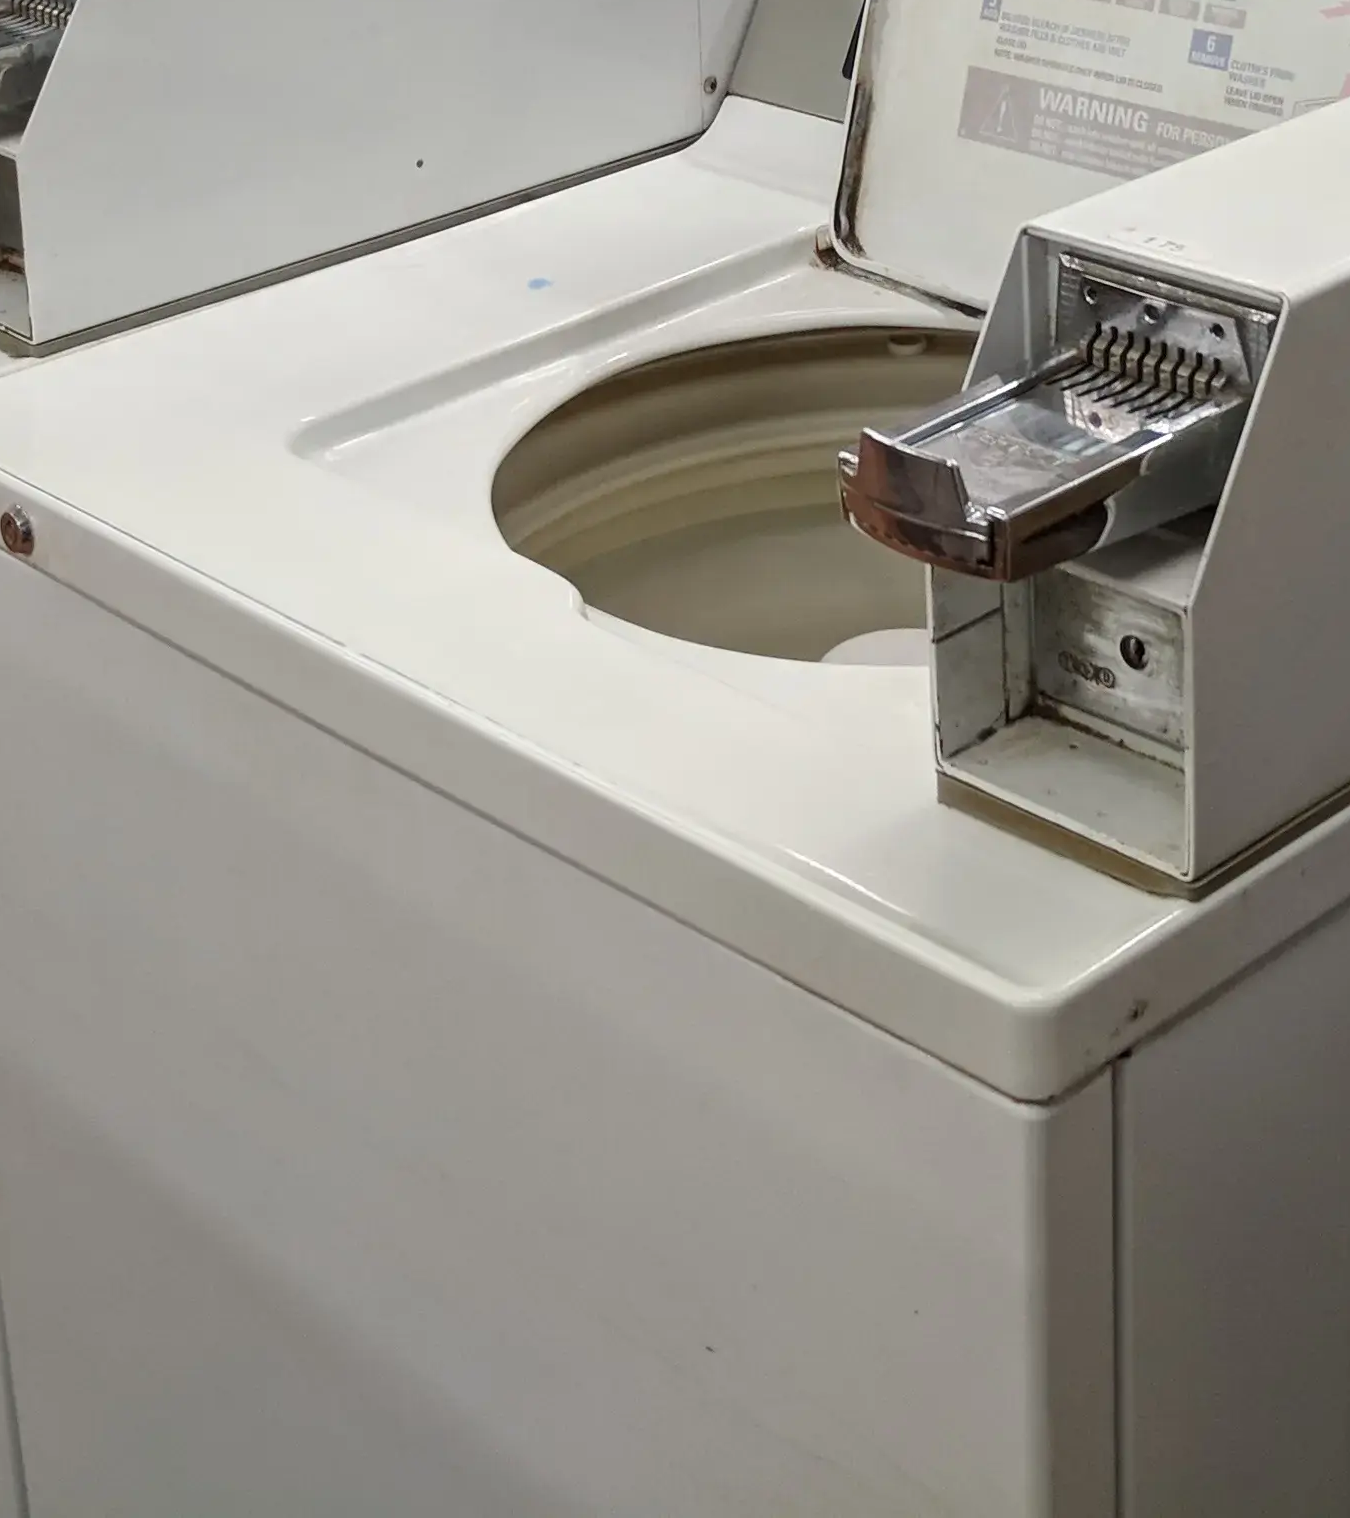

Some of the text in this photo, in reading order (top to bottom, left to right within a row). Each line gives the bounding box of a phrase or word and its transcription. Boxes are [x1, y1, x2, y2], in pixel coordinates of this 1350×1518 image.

[1207, 35, 1217, 52] 6
[1039, 87, 1150, 133] WARNING
[1156, 122, 1180, 142] FOR
